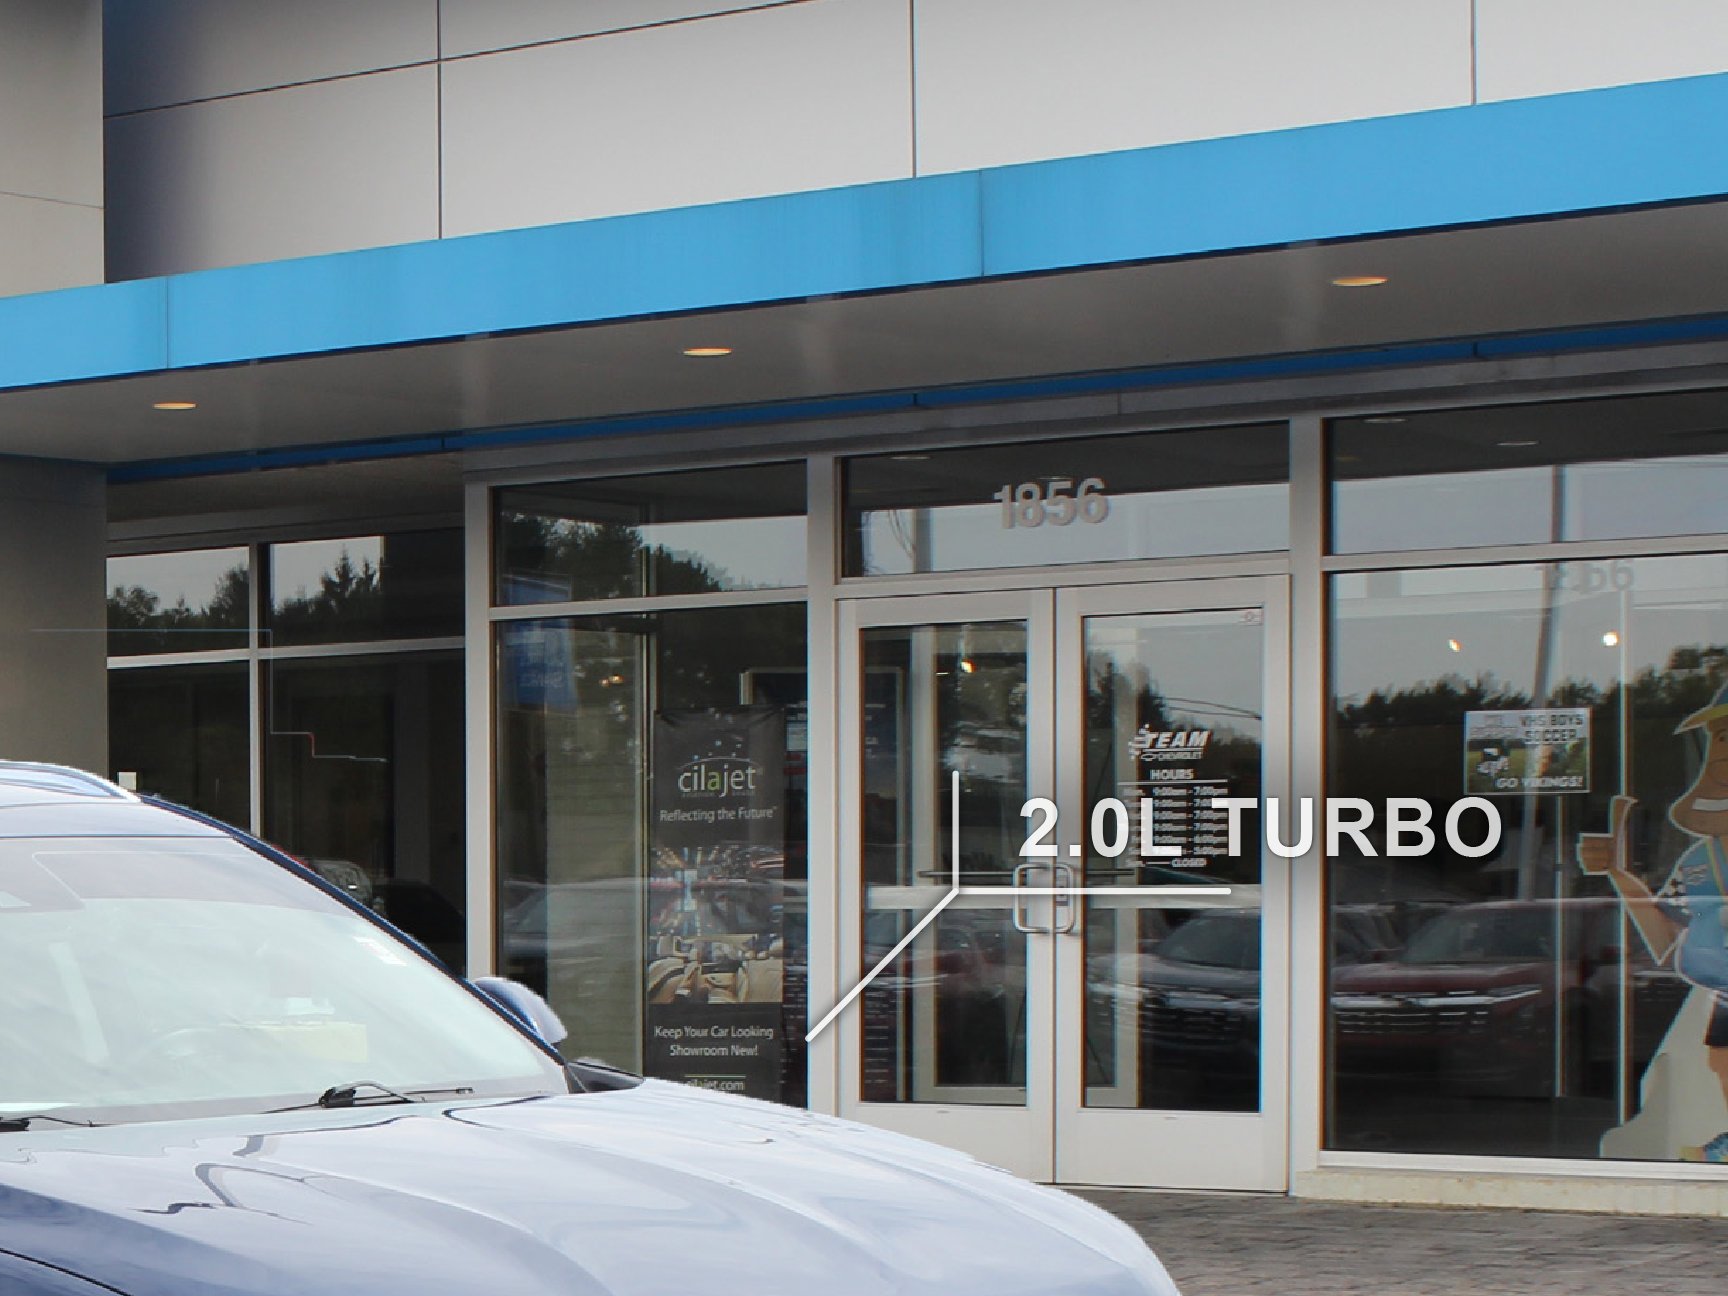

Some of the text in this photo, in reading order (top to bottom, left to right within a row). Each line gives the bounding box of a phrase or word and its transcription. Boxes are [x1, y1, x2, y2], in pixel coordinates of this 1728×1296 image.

[993, 477, 1109, 529] 1856
[1550, 713, 1585, 726] BOYS
[1144, 730, 1210, 748] TEAM
[1524, 728, 1578, 742] SOCCER
[678, 764, 757, 797] cilajet
[1150, 768, 1194, 780] HOURS
[1495, 777, 1519, 789] GO
[659, 805, 773, 823] Reflecting the Future
[653, 1025, 774, 1039] Keep Your Car Looking
[669, 1043, 759, 1056] Showroom New!
